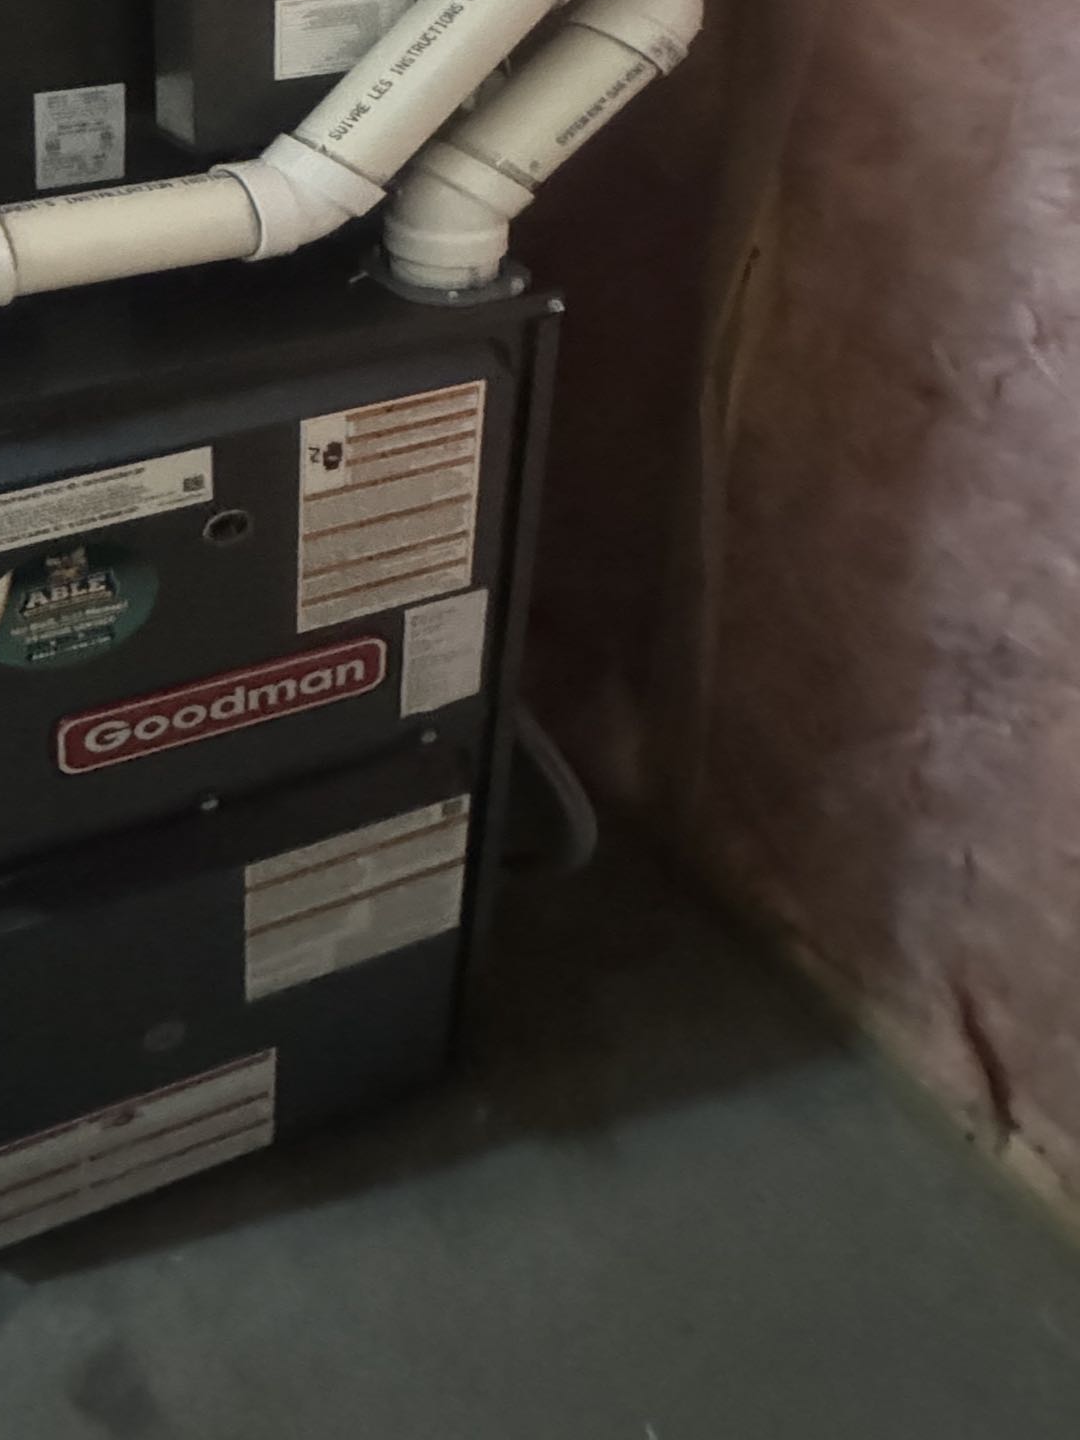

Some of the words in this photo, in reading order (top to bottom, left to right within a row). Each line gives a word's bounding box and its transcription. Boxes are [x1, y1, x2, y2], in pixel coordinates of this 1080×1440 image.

[328, 102, 372, 141] SUIVRE
[367, 79, 393, 101] LES
[390, 2, 464, 76] INSTRUCTIONS
[25, 574, 107, 609] ABLE
[84, 658, 366, 753] Goodman
